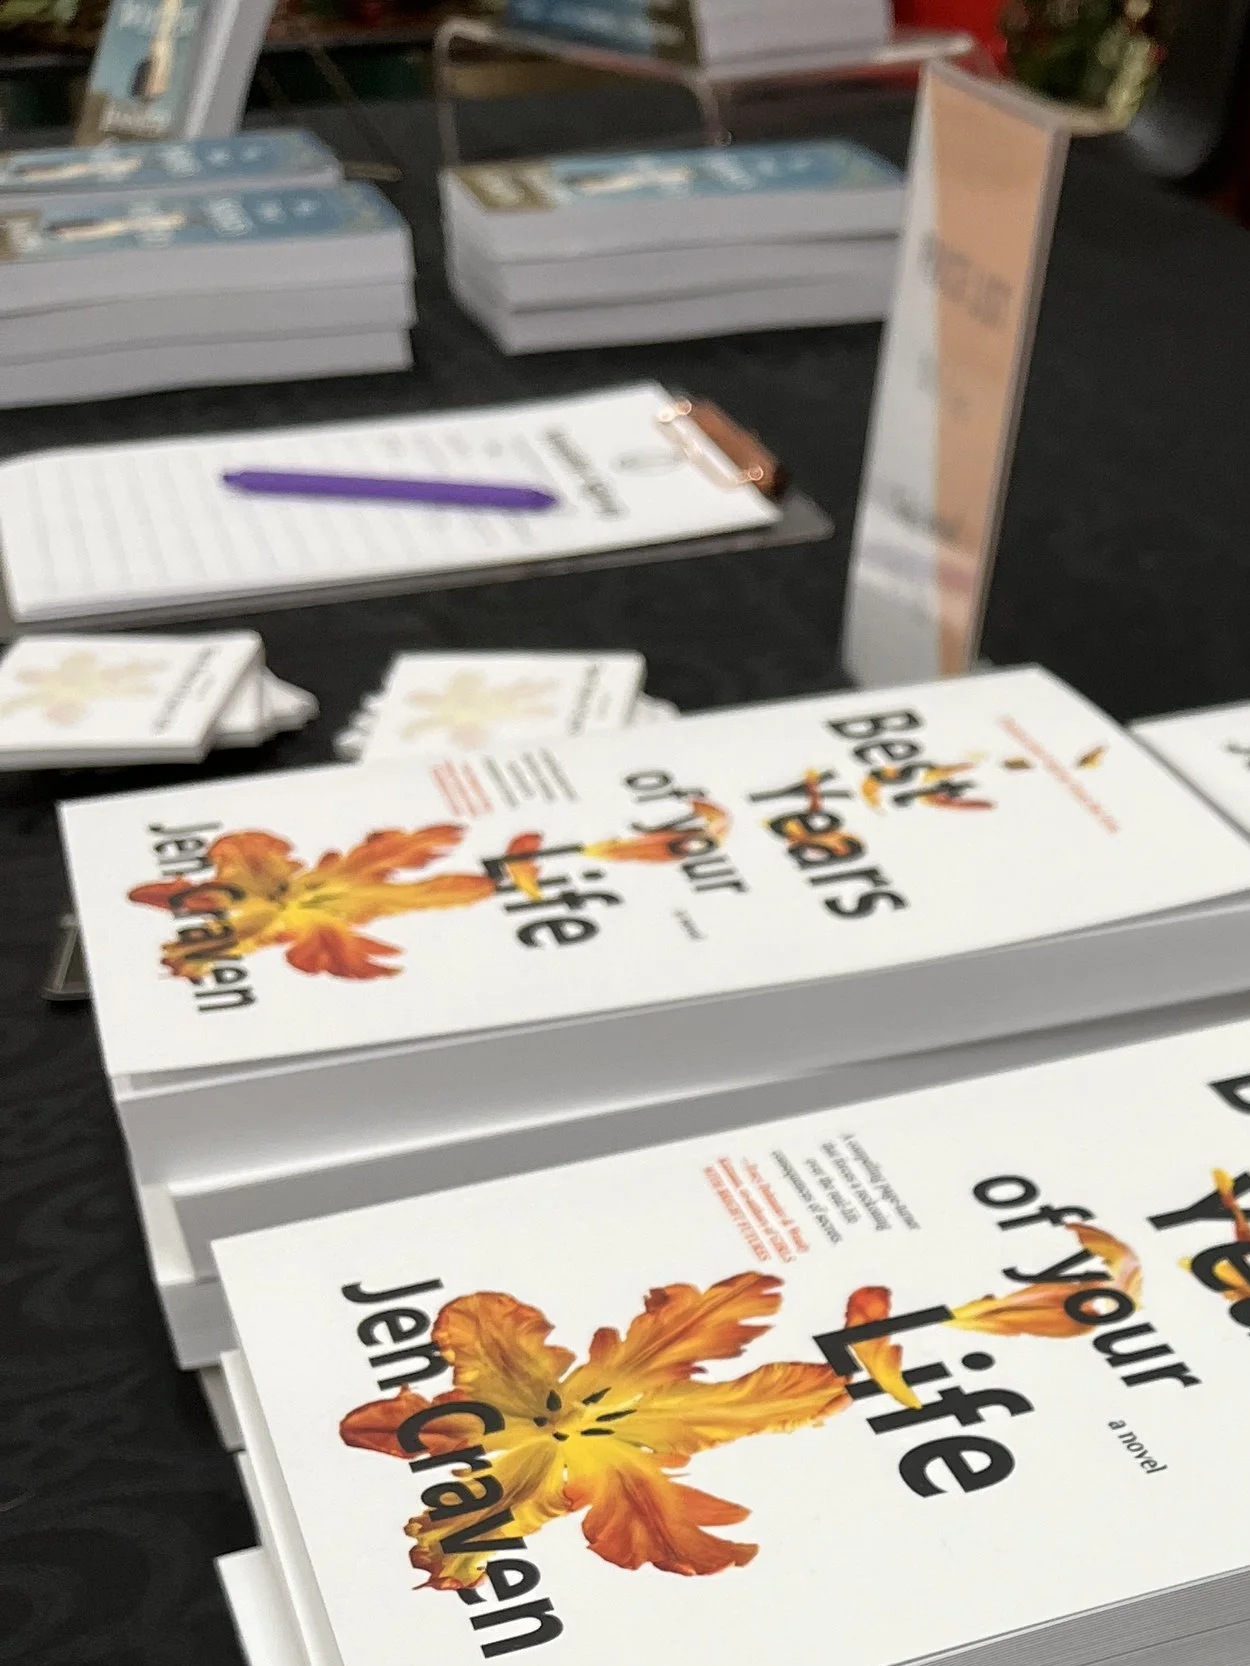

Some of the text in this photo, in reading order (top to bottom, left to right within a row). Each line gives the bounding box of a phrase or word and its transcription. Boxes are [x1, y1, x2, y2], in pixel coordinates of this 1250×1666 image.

[827, 708, 977, 806] Best
[148, 821, 221, 877] Jen
[482, 843, 624, 948] Life
[632, 808, 750, 892] your
[750, 769, 909, 918] Years
[972, 1174, 1203, 1390] of your
[811, 1303, 1035, 1499] Life
[1107, 1417, 1168, 1475] a novel
[341, 1277, 564, 1660] Jen Craven
